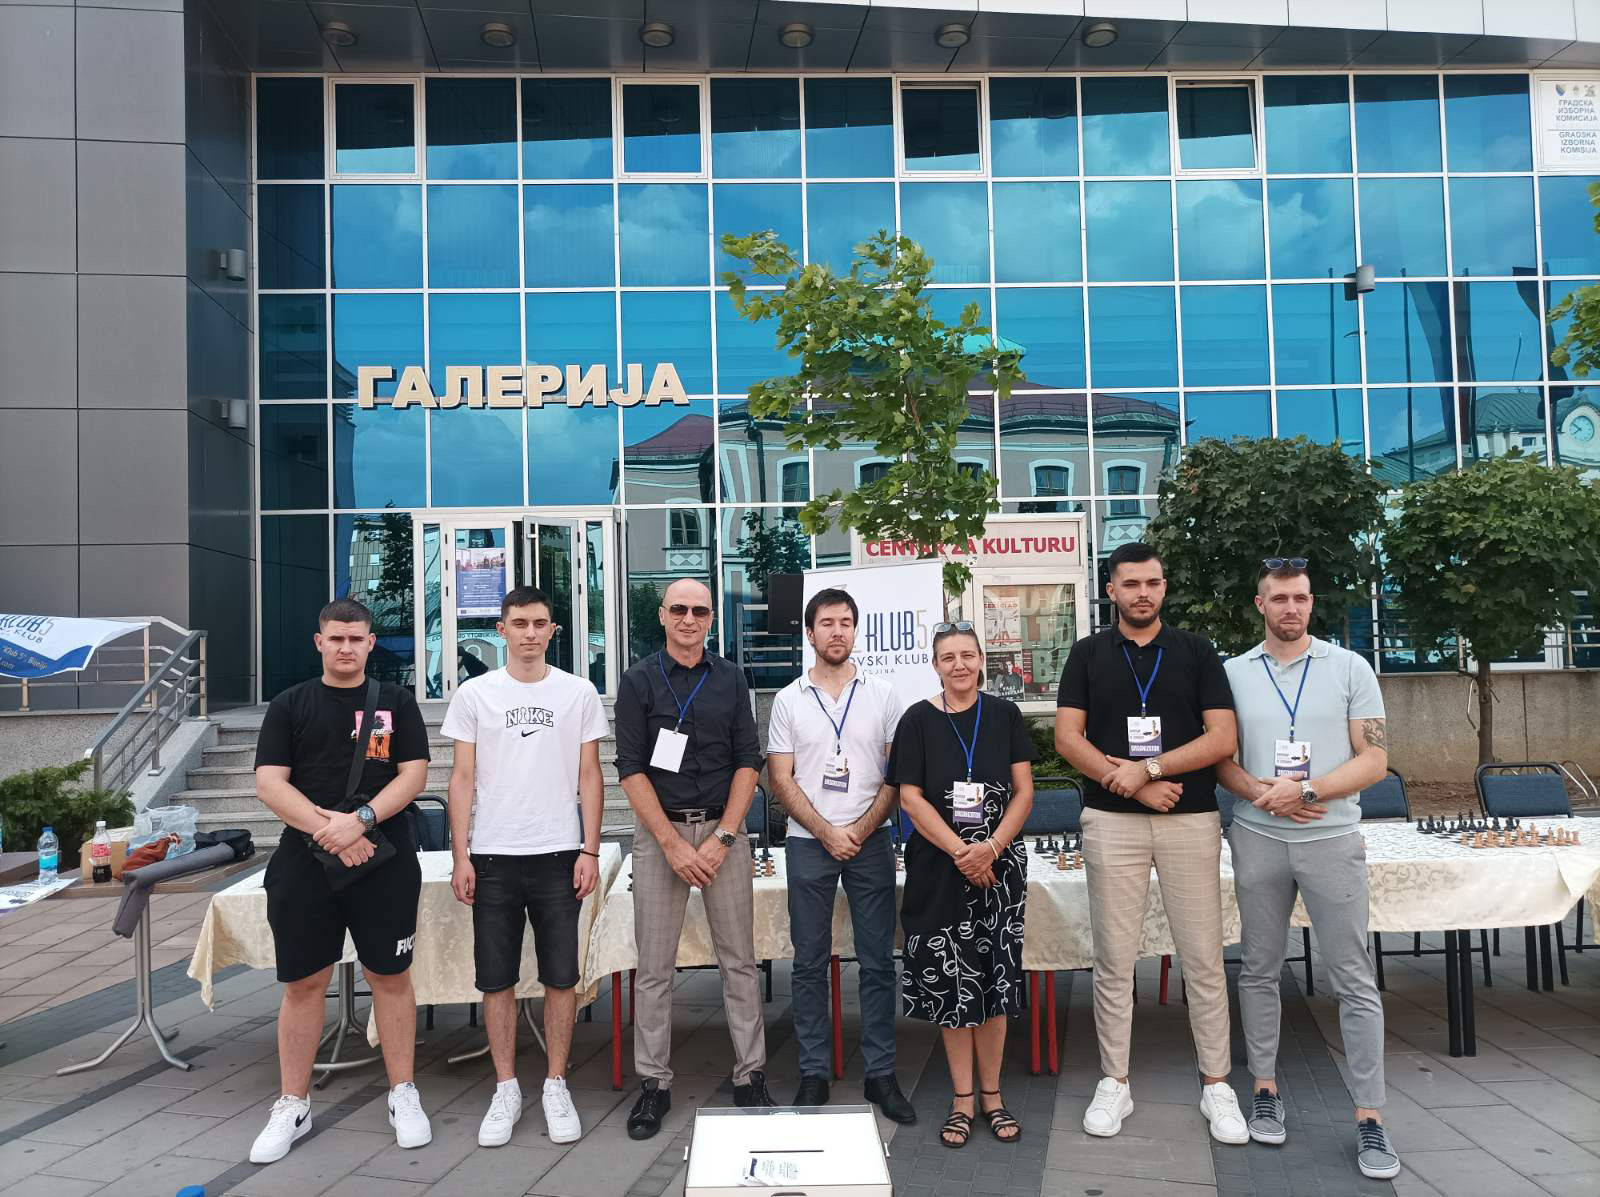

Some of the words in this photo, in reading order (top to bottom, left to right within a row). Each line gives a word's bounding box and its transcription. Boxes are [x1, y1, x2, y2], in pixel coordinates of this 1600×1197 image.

[357, 362, 690, 409] ГАЛЕРИЈА
[983, 536, 1075, 555] KULTURU
[848, 655, 888, 666] VSKI
[895, 653, 929, 665] KLUB
[506, 707, 554, 728] NIKE
